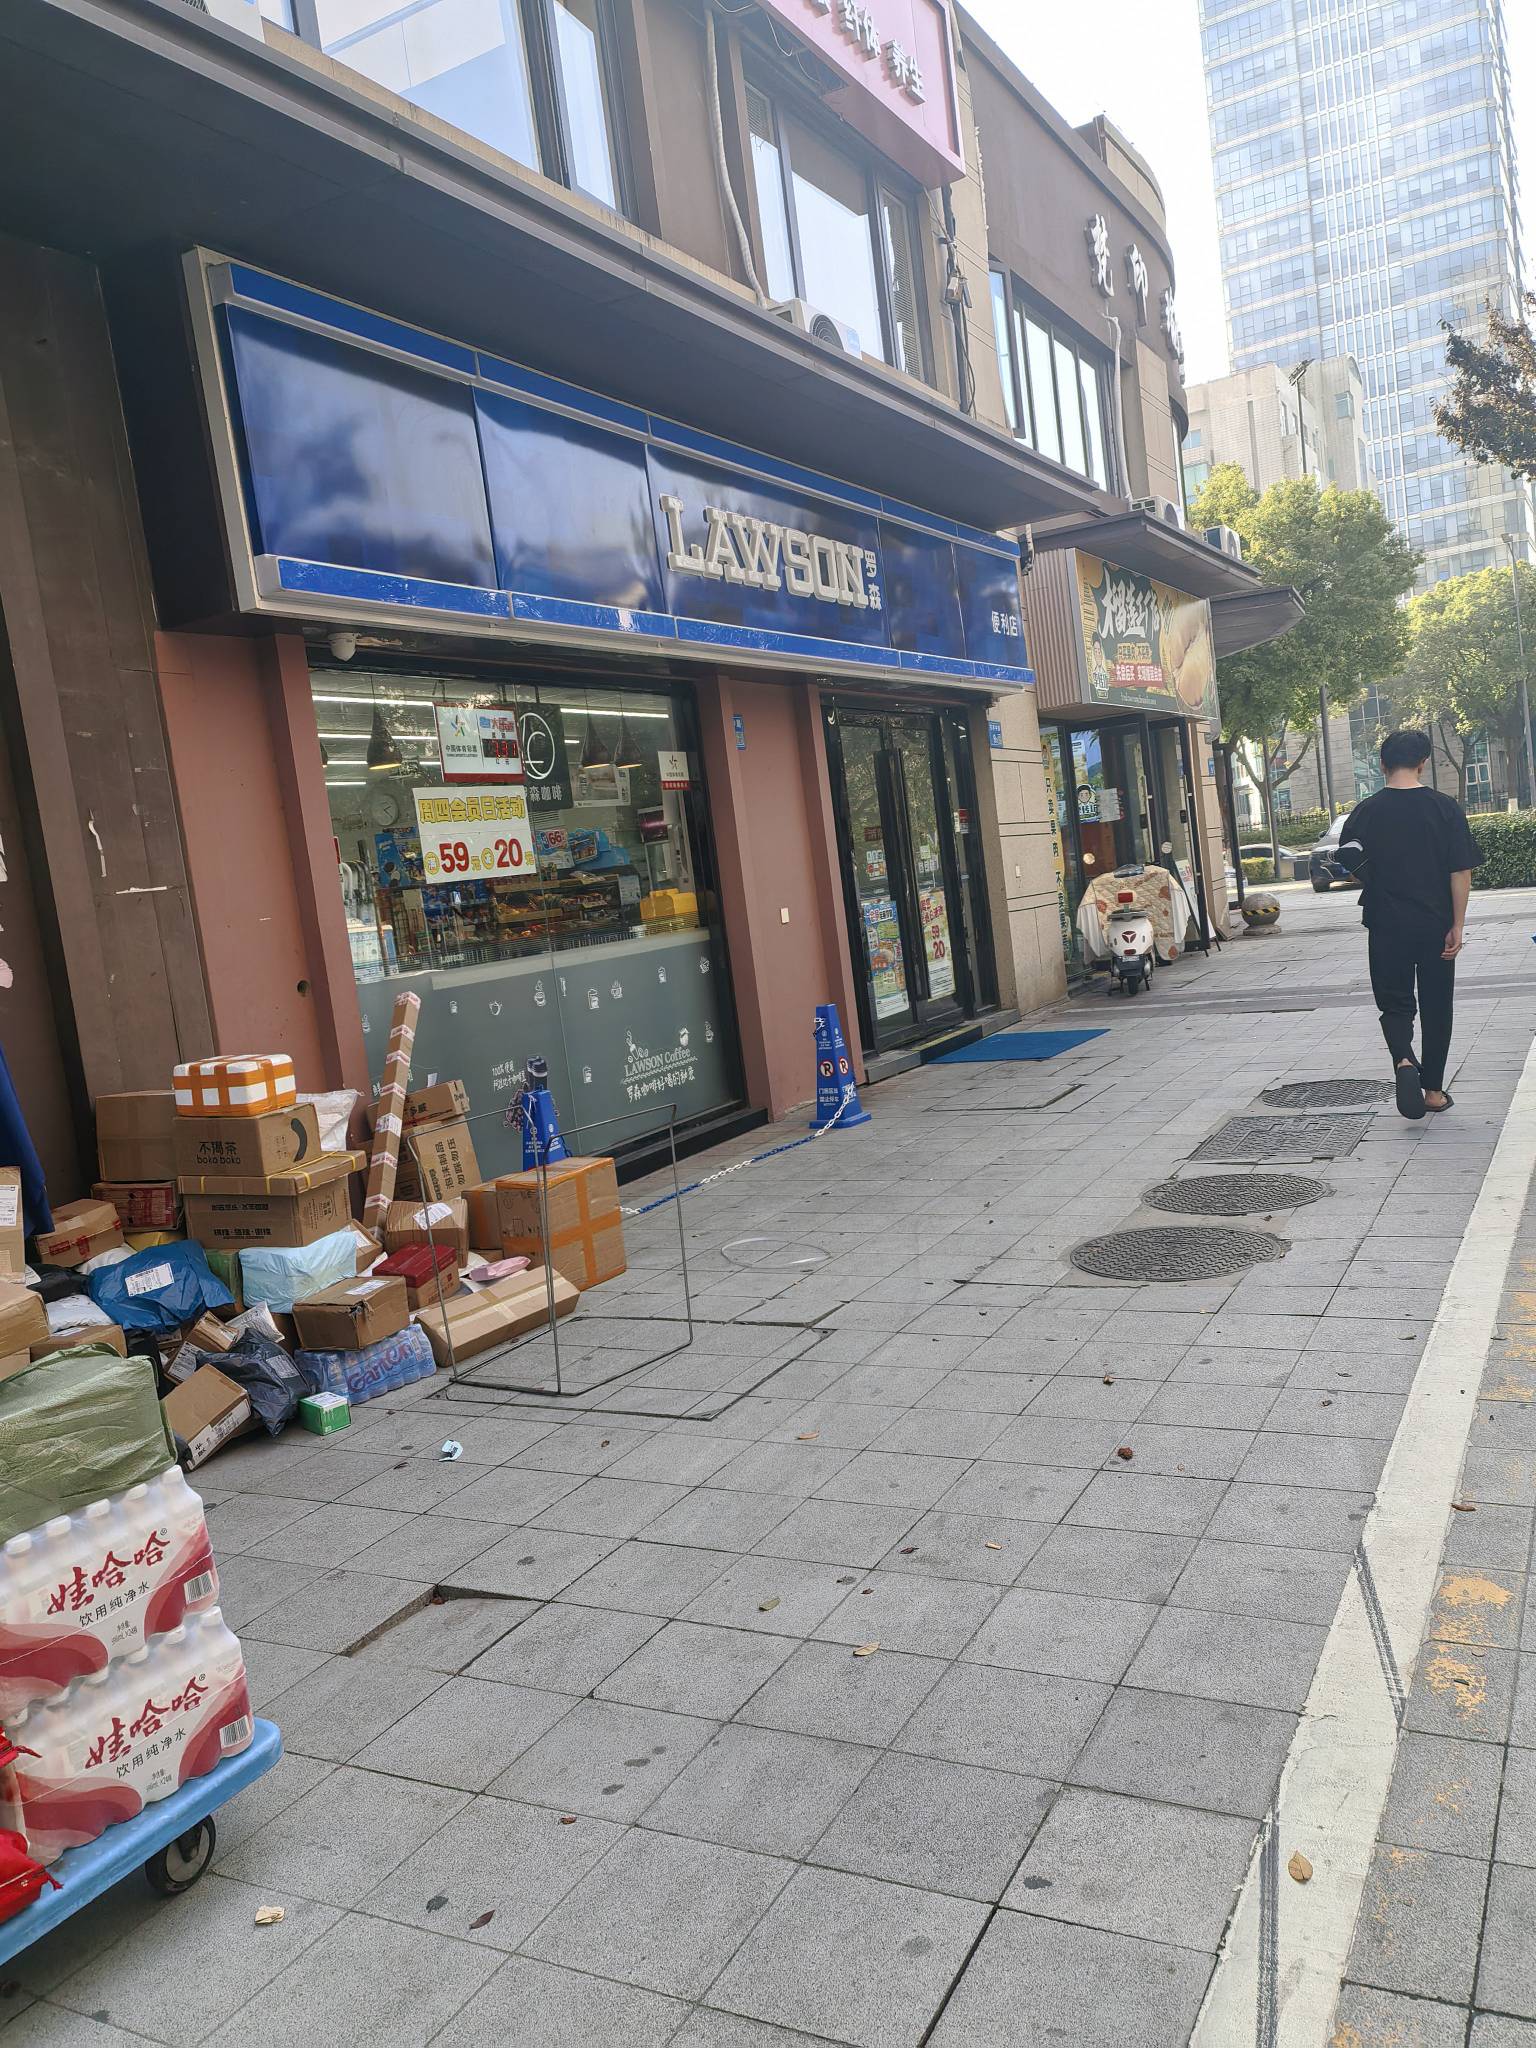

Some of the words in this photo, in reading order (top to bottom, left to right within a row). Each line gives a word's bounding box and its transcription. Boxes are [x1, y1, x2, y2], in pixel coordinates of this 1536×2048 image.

[660, 493, 868, 608] LAWSON
[865, 550, 882, 610] 罗森
[992, 611, 1019, 637] 便利店
[418, 795, 526, 824] 周四会员日活动
[933, 941, 945, 959] 20
[624, 1055, 664, 1077] LAWSON
[665, 1047, 691, 1064] Coffee
[435, 1141, 452, 1189] 泡沫制品
[447, 1138, 465, 1184] 勿踩勿压
[46, 1530, 170, 1615] 娃哈哈
[79, 1580, 150, 1627] 饮用纯净水
[85, 1676, 208, 1769] 娃哈哈
[116, 1727, 187, 1778] 饮用纯净水
